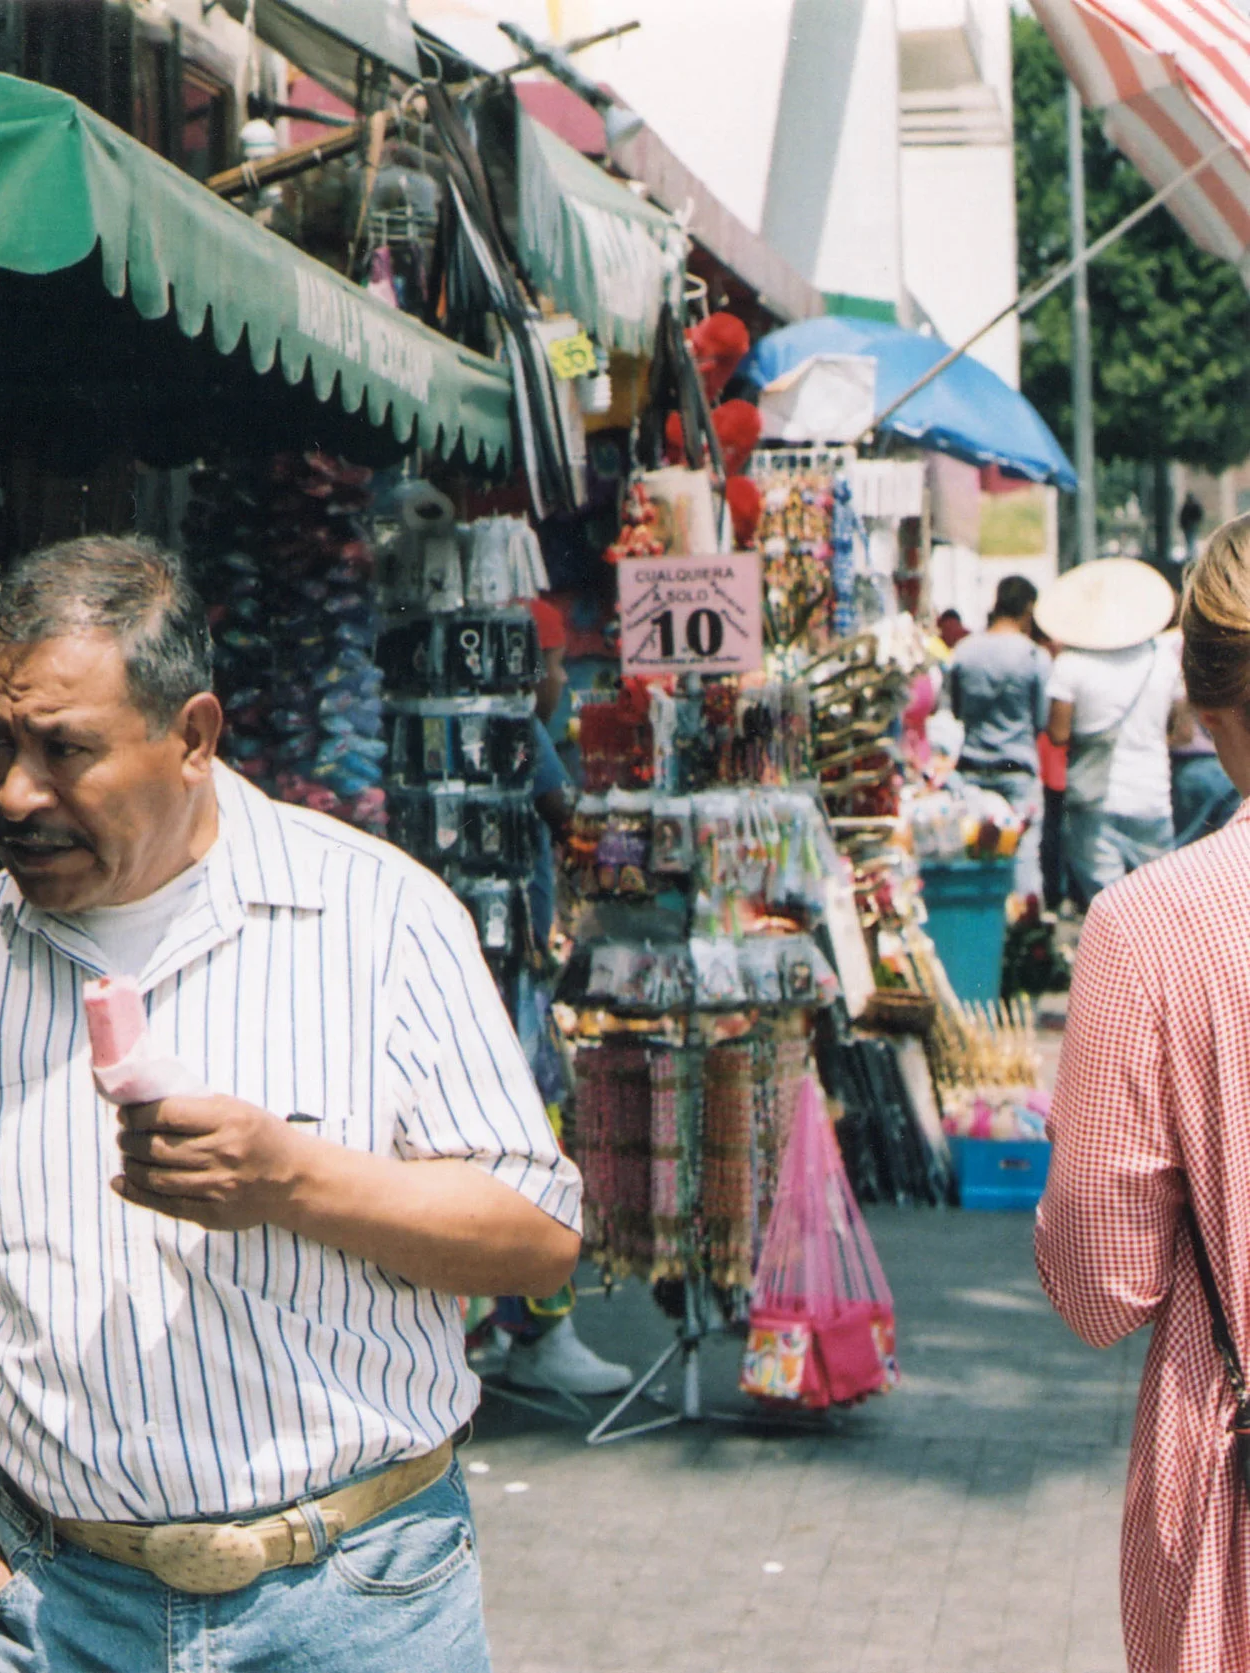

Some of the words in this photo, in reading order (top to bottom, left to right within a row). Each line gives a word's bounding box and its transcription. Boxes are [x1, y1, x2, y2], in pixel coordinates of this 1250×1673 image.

[635, 567, 734, 583] CUALQUIERA
[667, 589, 708, 603] SOLO
[652, 608, 724, 657] 10
